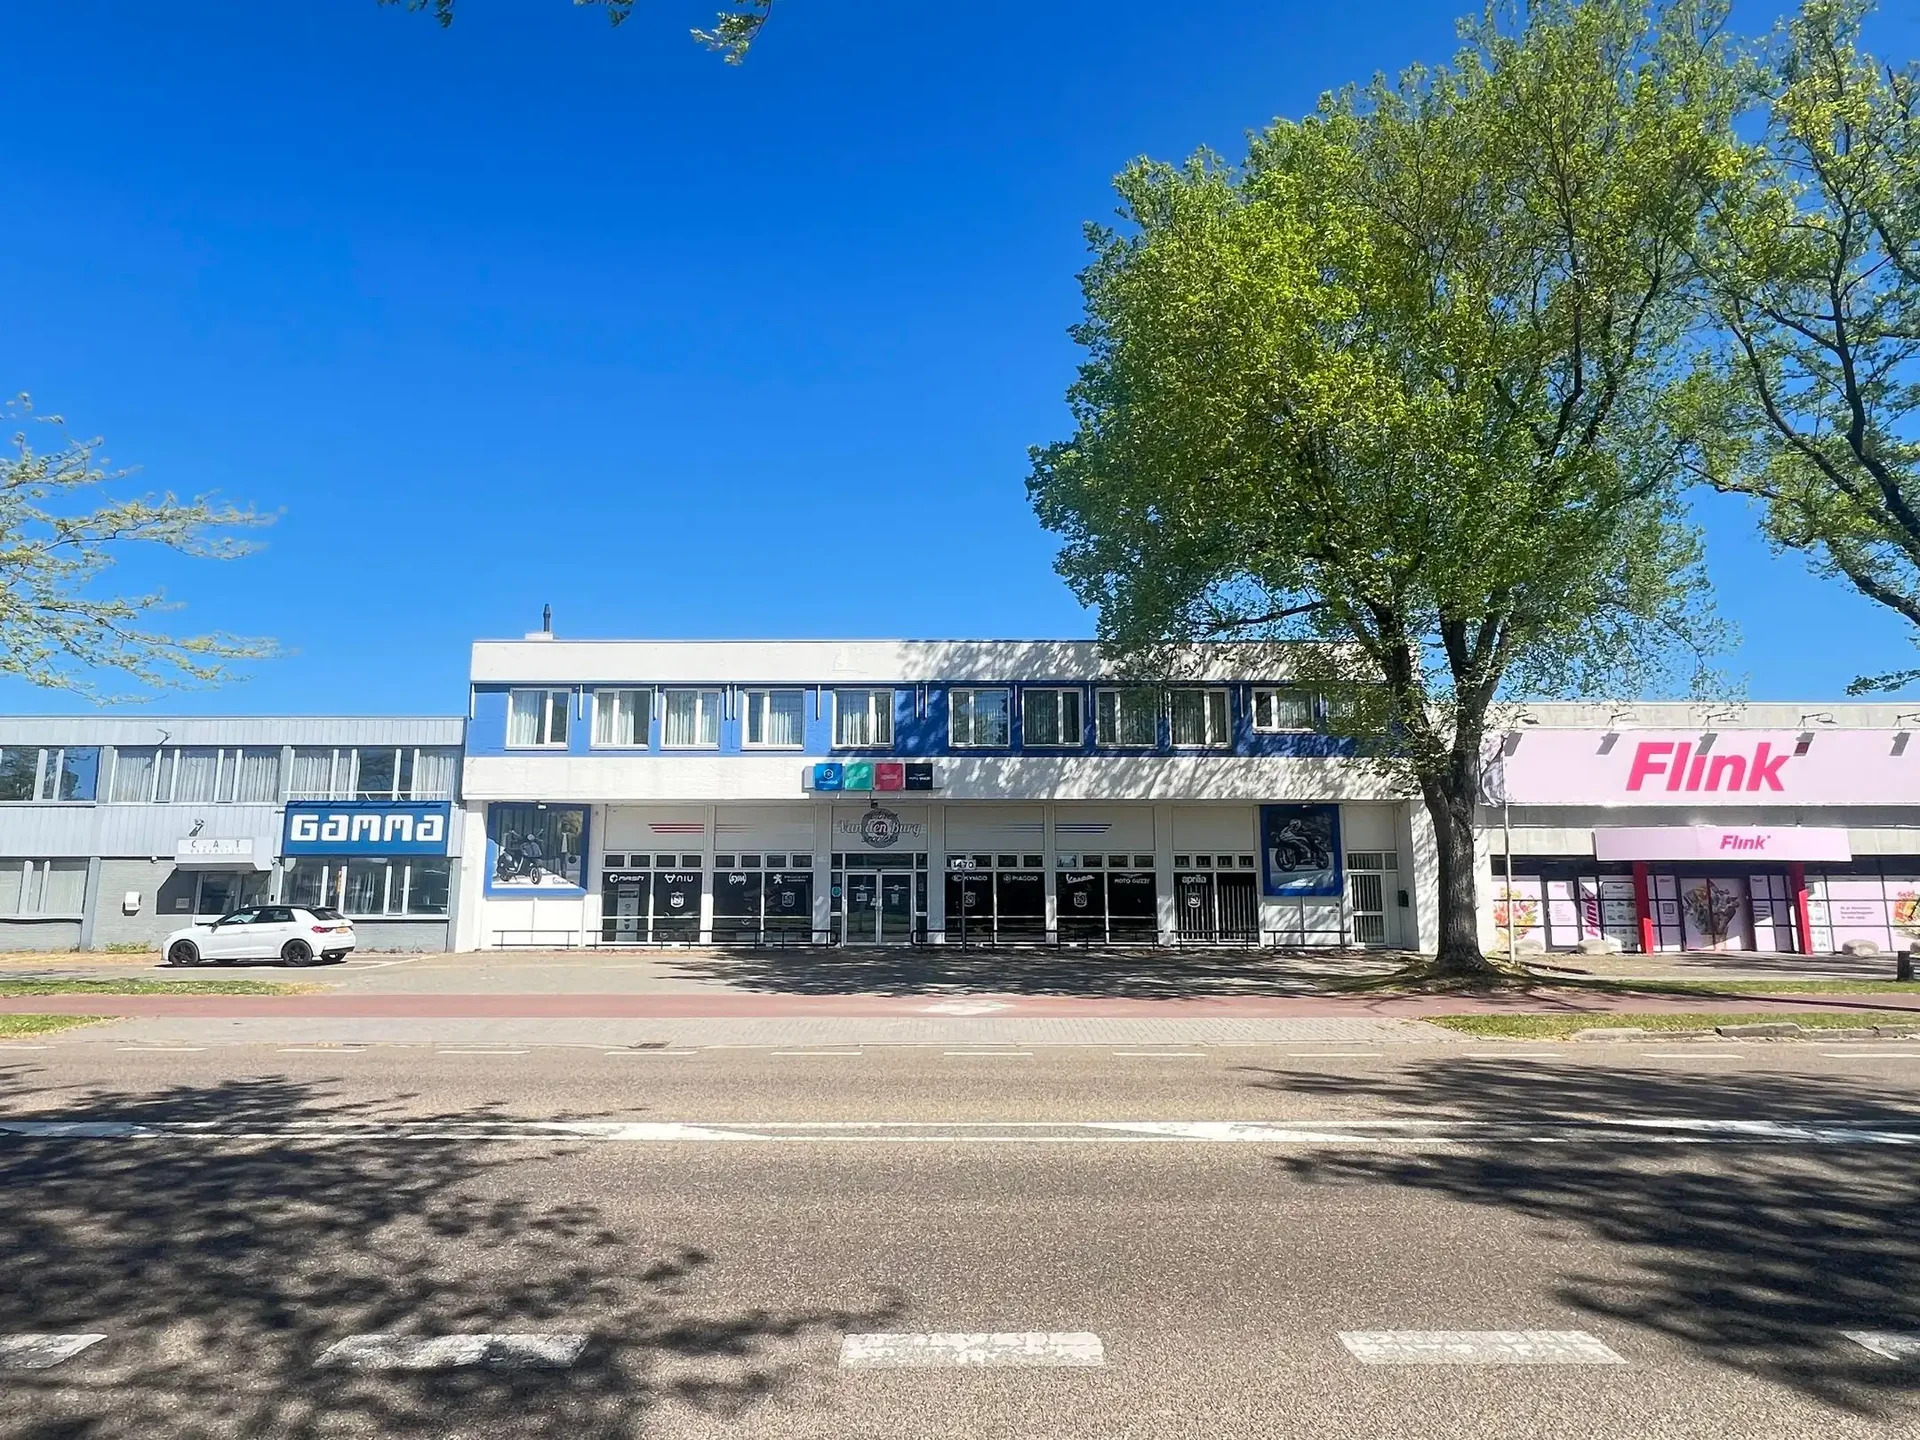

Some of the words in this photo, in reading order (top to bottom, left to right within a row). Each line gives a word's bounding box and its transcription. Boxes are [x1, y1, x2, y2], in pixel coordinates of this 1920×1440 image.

[1625, 742, 1790, 792] Flink
[1720, 835, 1766, 850] Flink
[953, 861, 974, 869] 1470
[1182, 875, 1207, 884] aprilia
